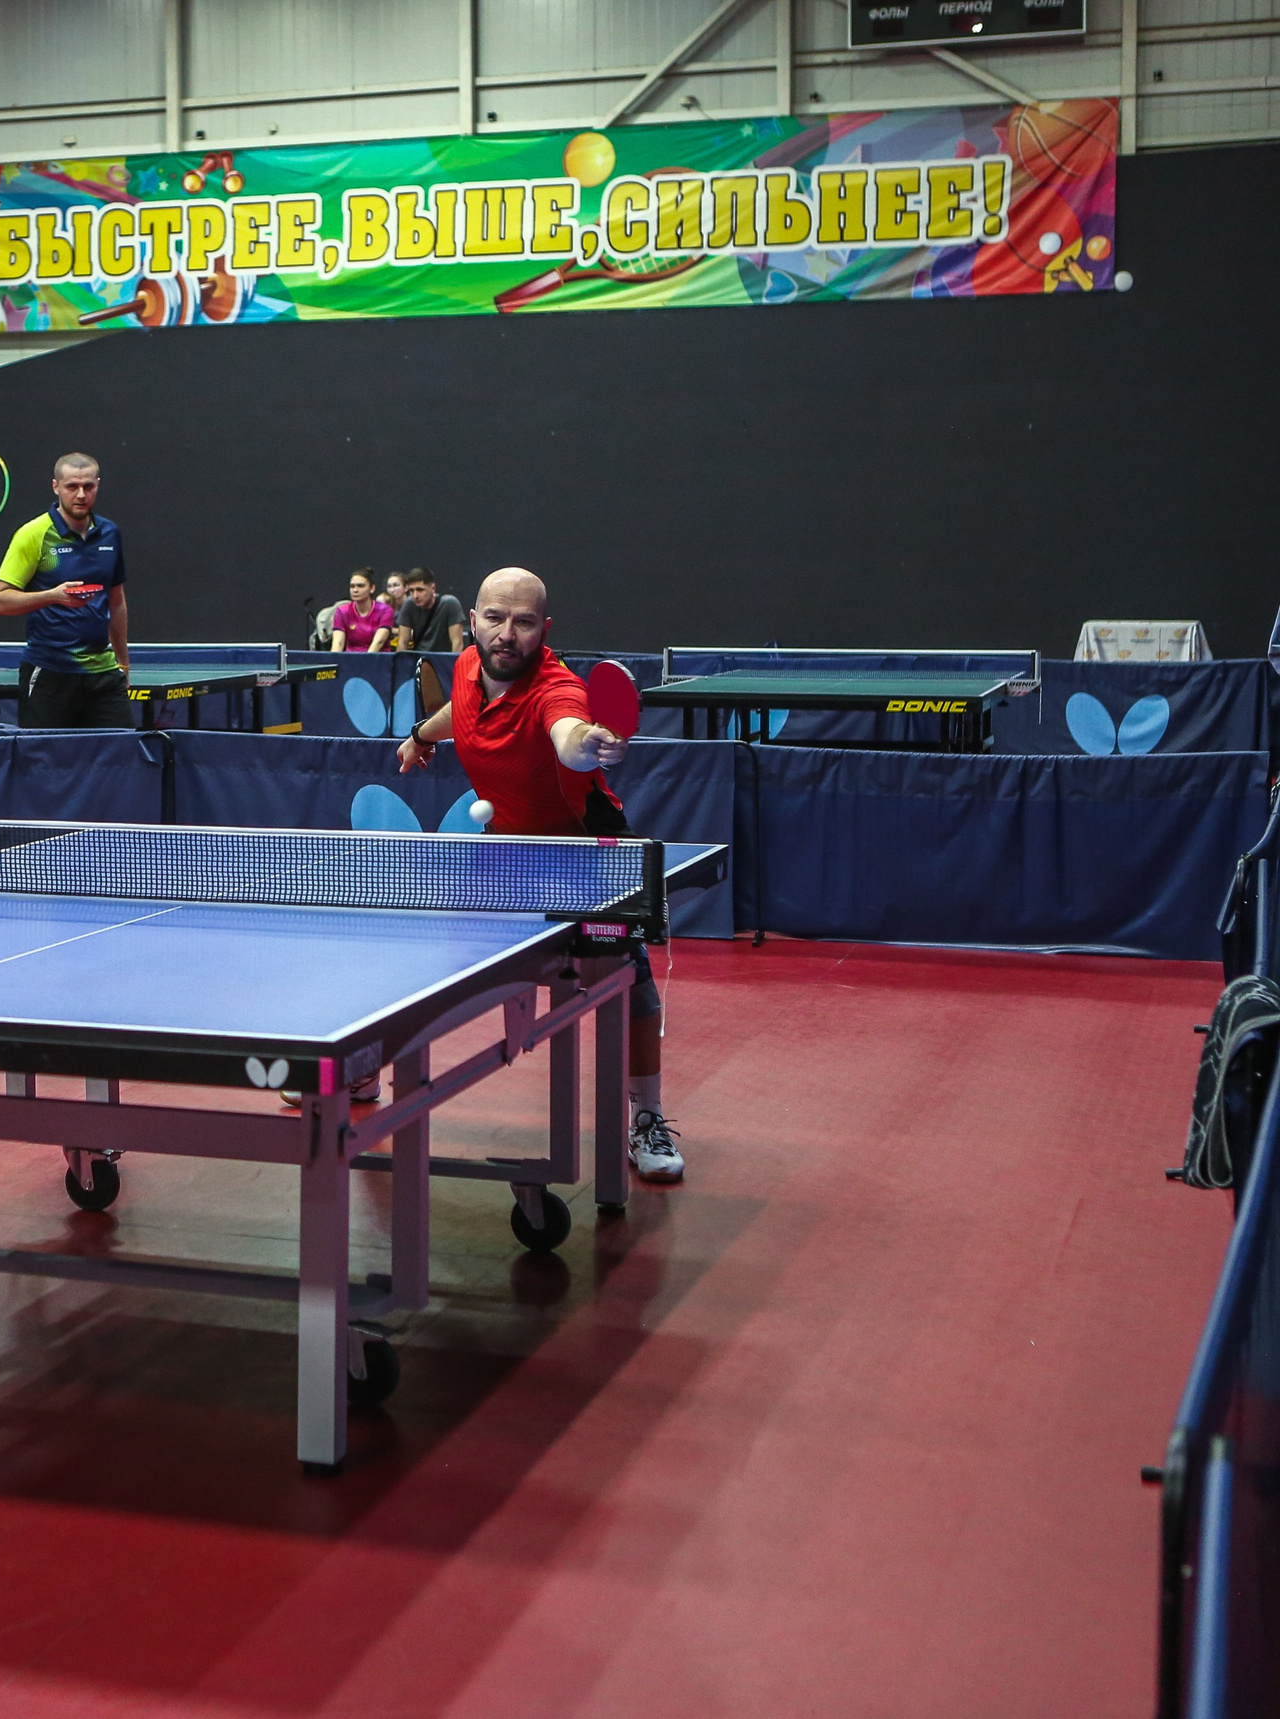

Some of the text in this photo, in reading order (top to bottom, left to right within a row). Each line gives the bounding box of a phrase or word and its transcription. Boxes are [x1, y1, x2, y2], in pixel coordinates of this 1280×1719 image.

[869, 6, 909, 20] ФОЛЫ
[939, 1, 993, 15] ПЕРИОД
[347, 184, 601, 263] ВЫШЕ,
[606, 161, 1008, 254] СИЛЬНЕЕ!
[317, 670, 337, 681] DONIC
[167, 687, 193, 699] DONIC
[886, 700, 966, 713] DONIC
[586, 924, 622, 936] BUTTERFLY
